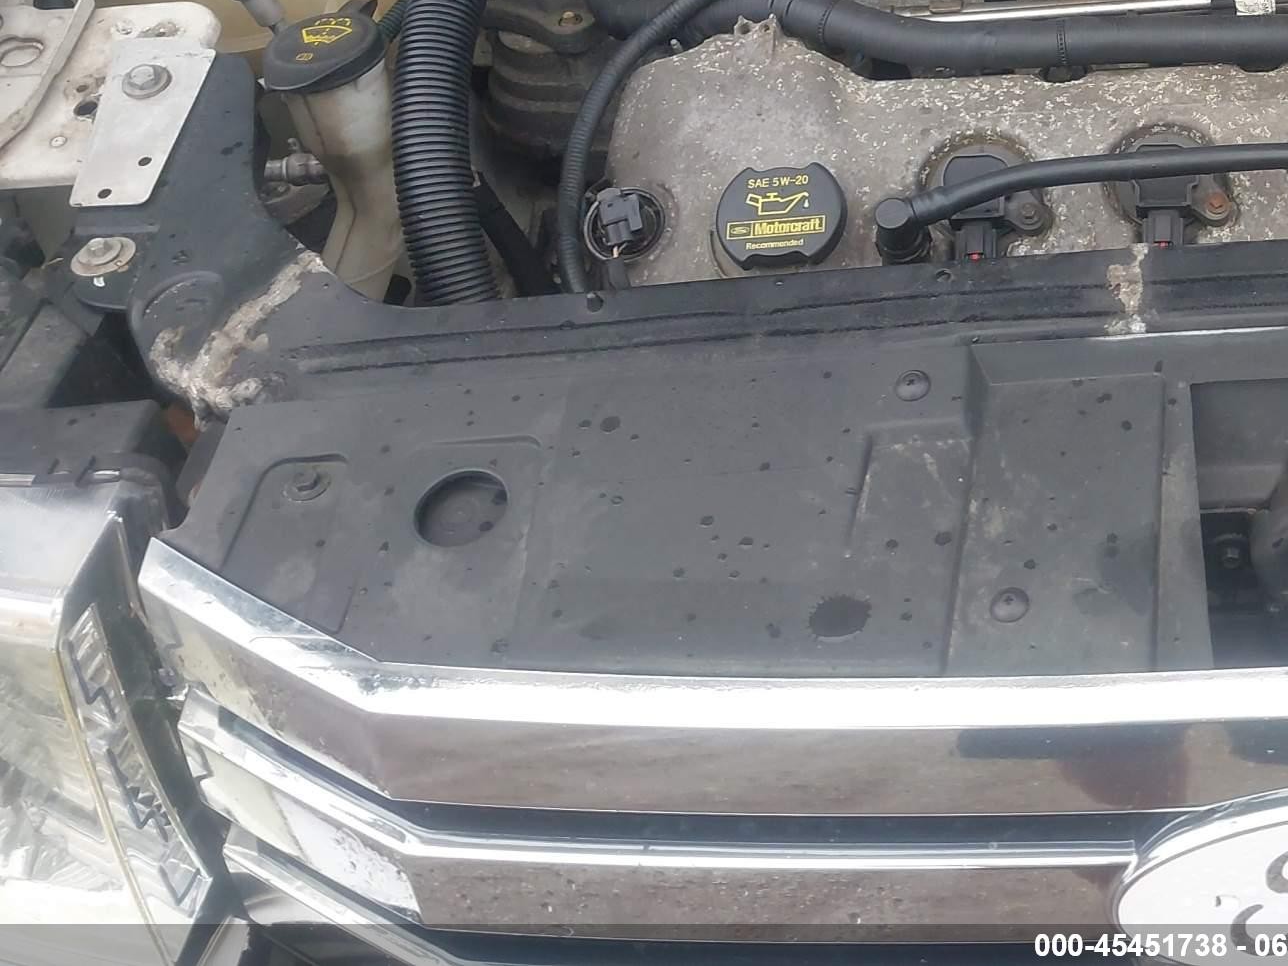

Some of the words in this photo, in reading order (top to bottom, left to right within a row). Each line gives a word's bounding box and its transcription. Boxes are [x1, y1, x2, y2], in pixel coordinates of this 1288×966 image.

[747, 177, 770, 189] SAE
[772, 175, 809, 187] 5W-20
[754, 218, 821, 235] Motorcraft
[745, 238, 804, 250] Recommended
